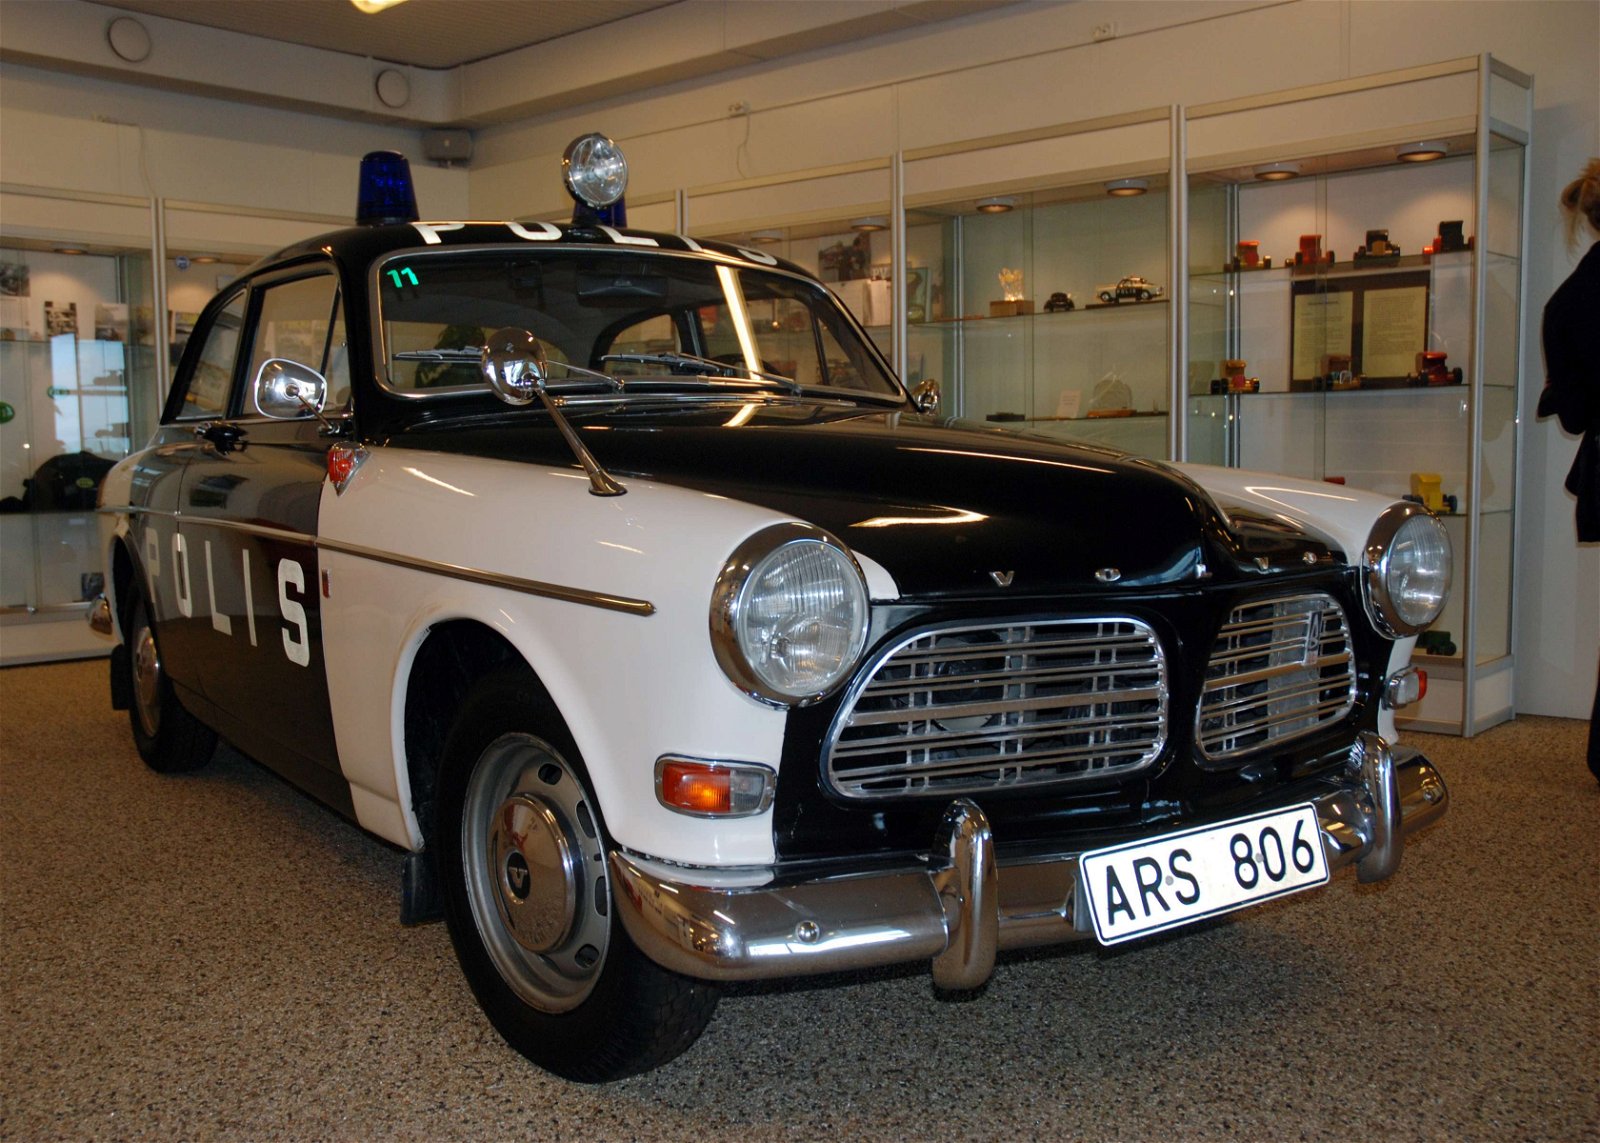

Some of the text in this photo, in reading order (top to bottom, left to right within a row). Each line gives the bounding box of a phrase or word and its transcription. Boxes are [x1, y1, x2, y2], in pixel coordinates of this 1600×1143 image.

[387, 267, 419, 289] 11
[145, 527, 310, 668] POLIS
[1106, 819, 1314, 926] ARS 806
